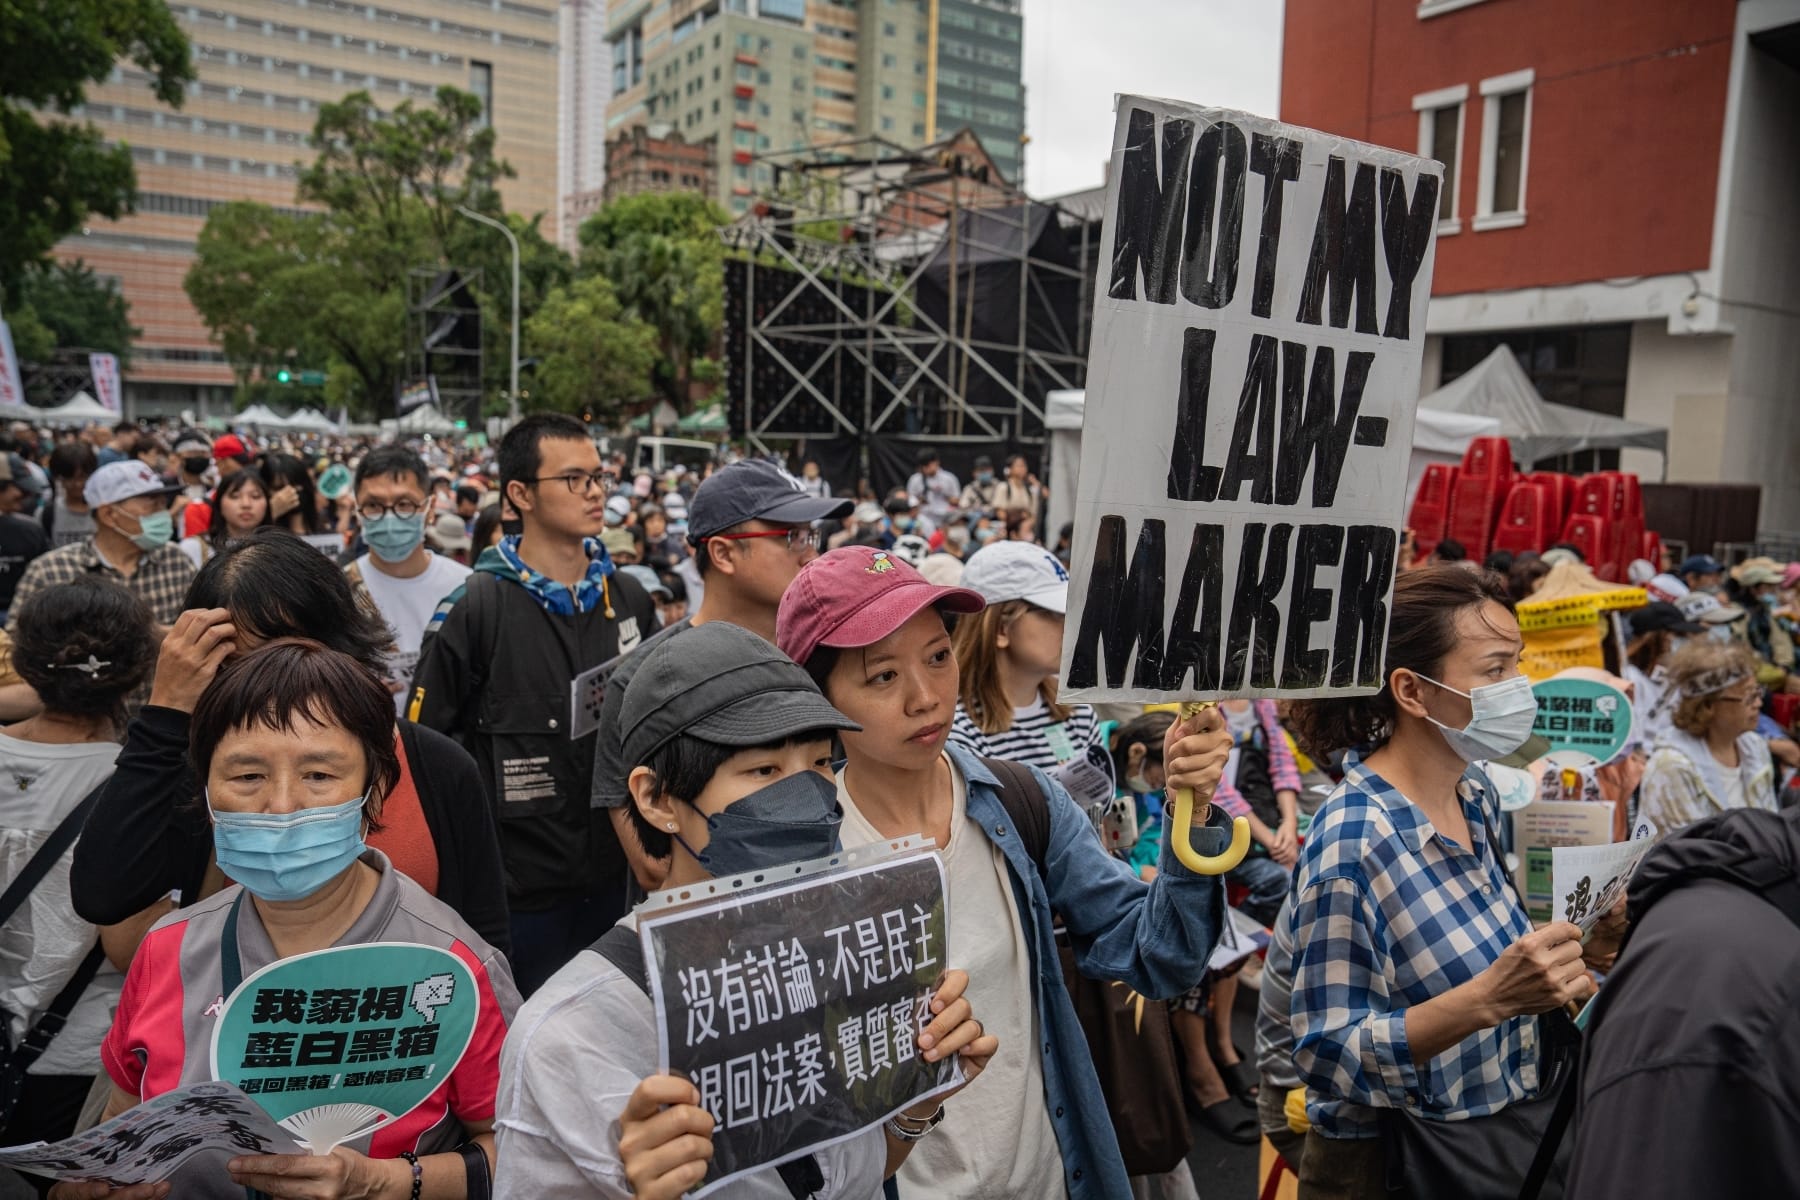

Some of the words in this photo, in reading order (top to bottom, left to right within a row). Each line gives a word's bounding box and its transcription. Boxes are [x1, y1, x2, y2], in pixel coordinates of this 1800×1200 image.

[1107, 108, 1303, 318] NOT
[1296, 154, 1439, 340] MY
[1167, 326, 1389, 508] LAW-
[1066, 515, 1396, 691] MAKER
[240, 1023, 440, 1069] 藍白黑箱
[251, 985, 408, 1024] 我藐視
[678, 903, 937, 1047] 沒有討論，不是民主
